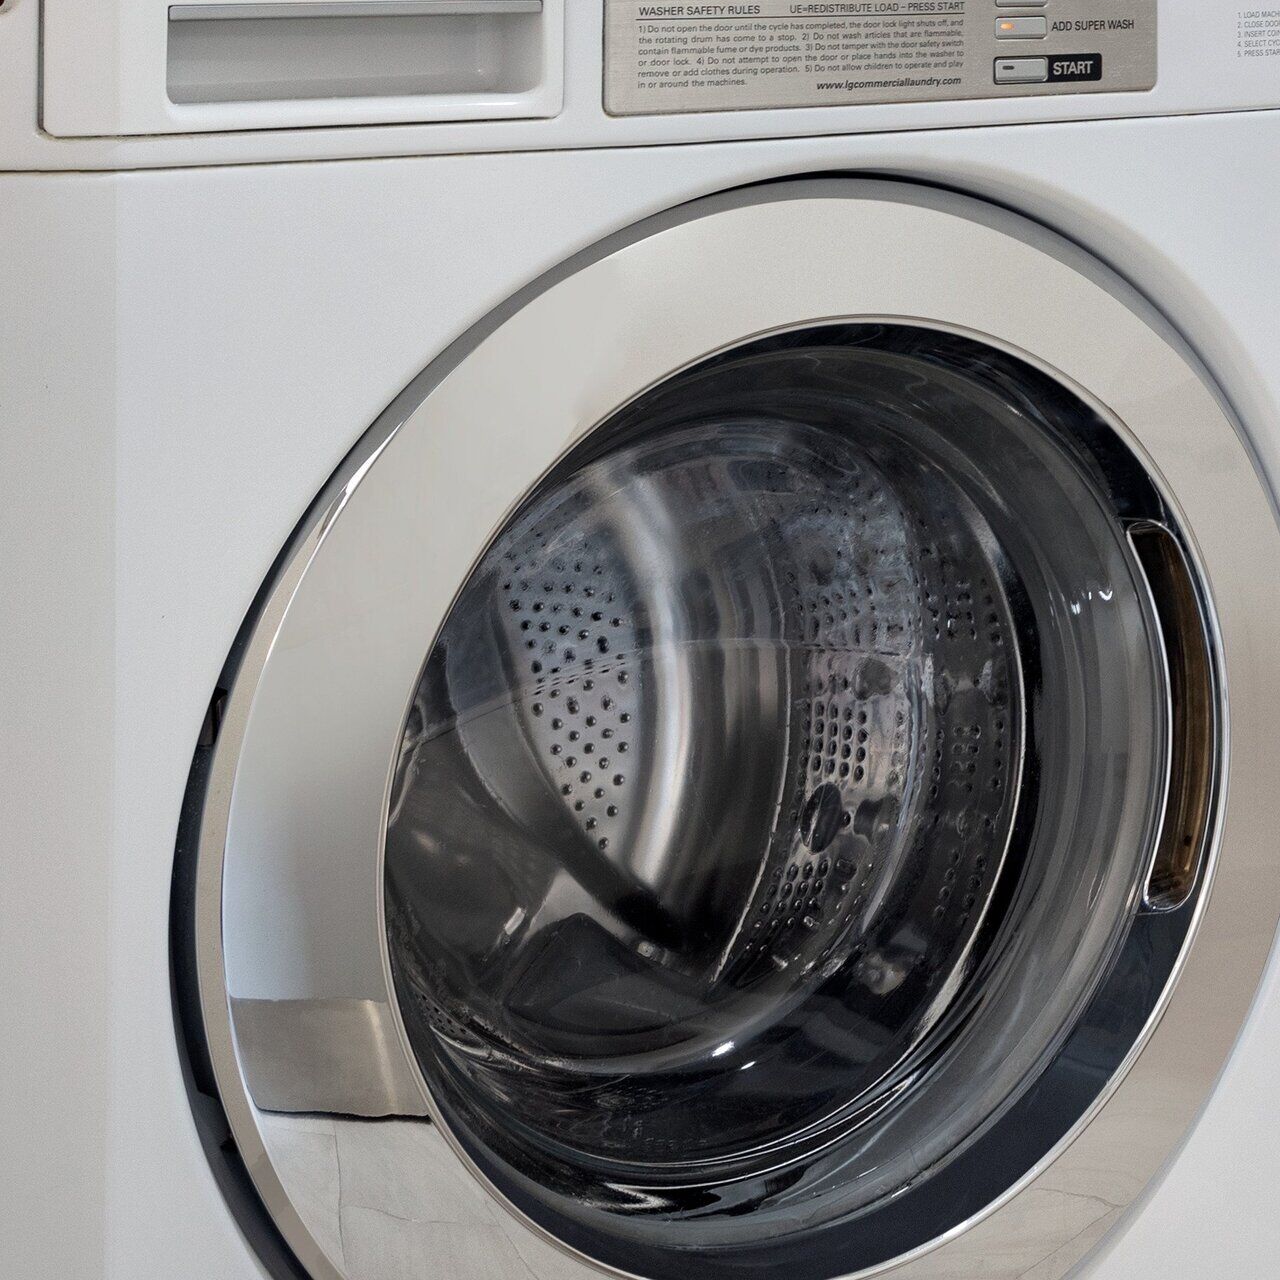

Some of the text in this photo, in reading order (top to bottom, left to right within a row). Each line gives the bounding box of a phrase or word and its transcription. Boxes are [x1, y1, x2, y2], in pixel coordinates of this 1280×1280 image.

[638, 5, 760, 16] WASHER SAFETY RULES
[874, 3, 899, 12] LOAD
[908, 2, 935, 11] PRESS
[938, 2, 964, 10] START
[676, 24, 697, 33] open
[768, 23, 788, 32] cycle
[898, 20, 914, 29] light
[1052, 20, 1134, 32] ADD SUPER WASH
[654, 36, 688, 44] rotating
[748, 45, 763, 53] dye
[841, 42, 868, 51] tamper
[918, 41, 940, 49] safety
[1053, 60, 1094, 75] START
[816, 77, 962, 90] www.lgcommerciallaundry.com
